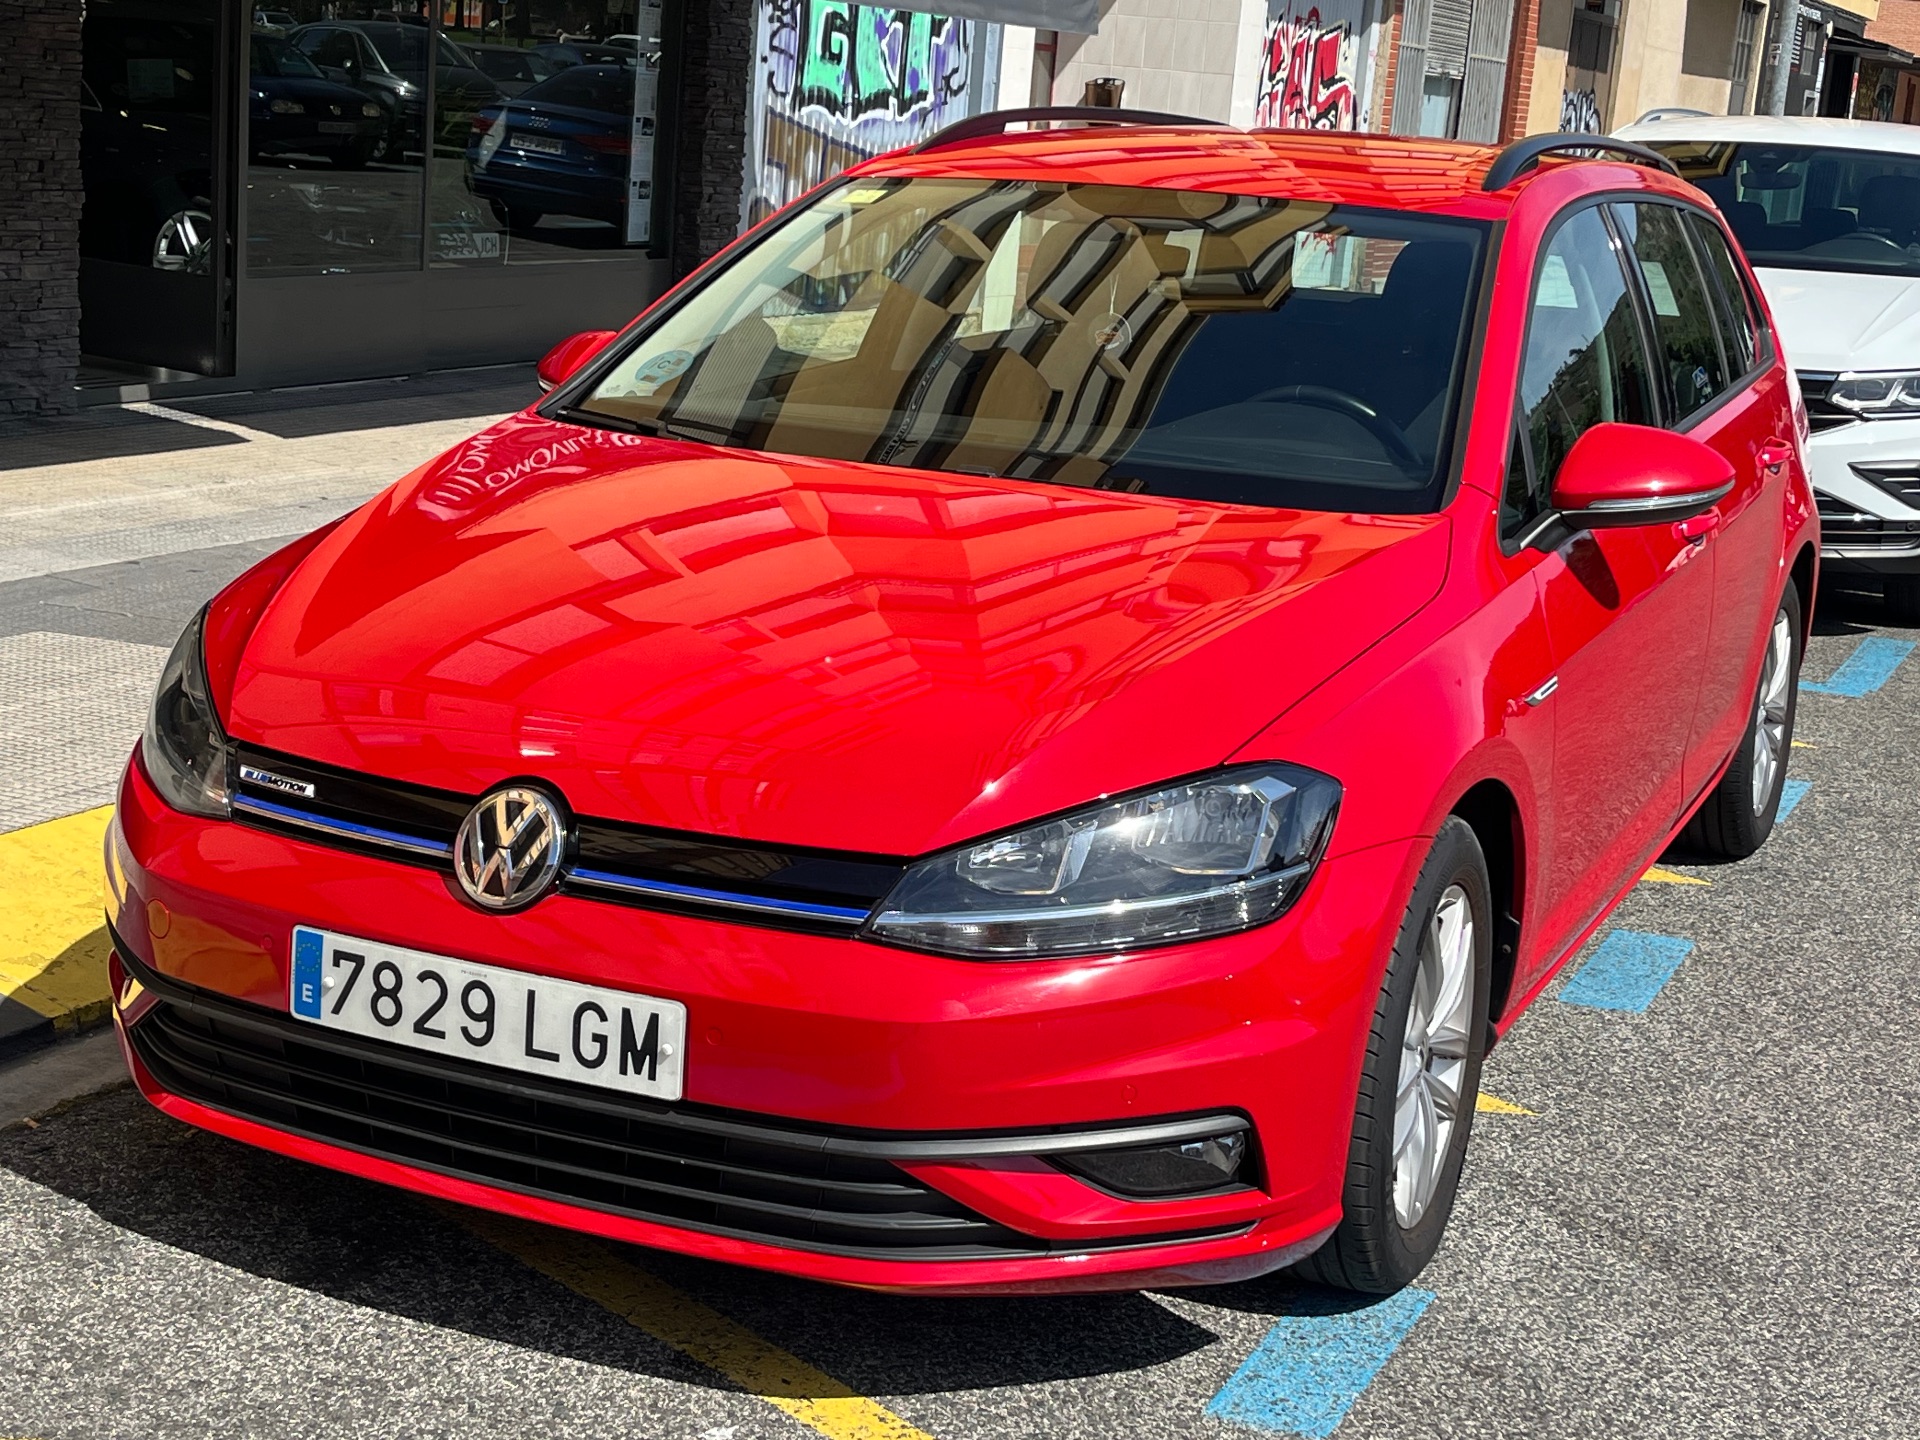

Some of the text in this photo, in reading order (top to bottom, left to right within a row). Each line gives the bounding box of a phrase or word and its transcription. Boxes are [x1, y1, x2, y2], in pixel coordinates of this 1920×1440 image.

[244, 769, 308, 793] BLUEMOTION
[302, 948, 660, 1082] E 7829 LGM
